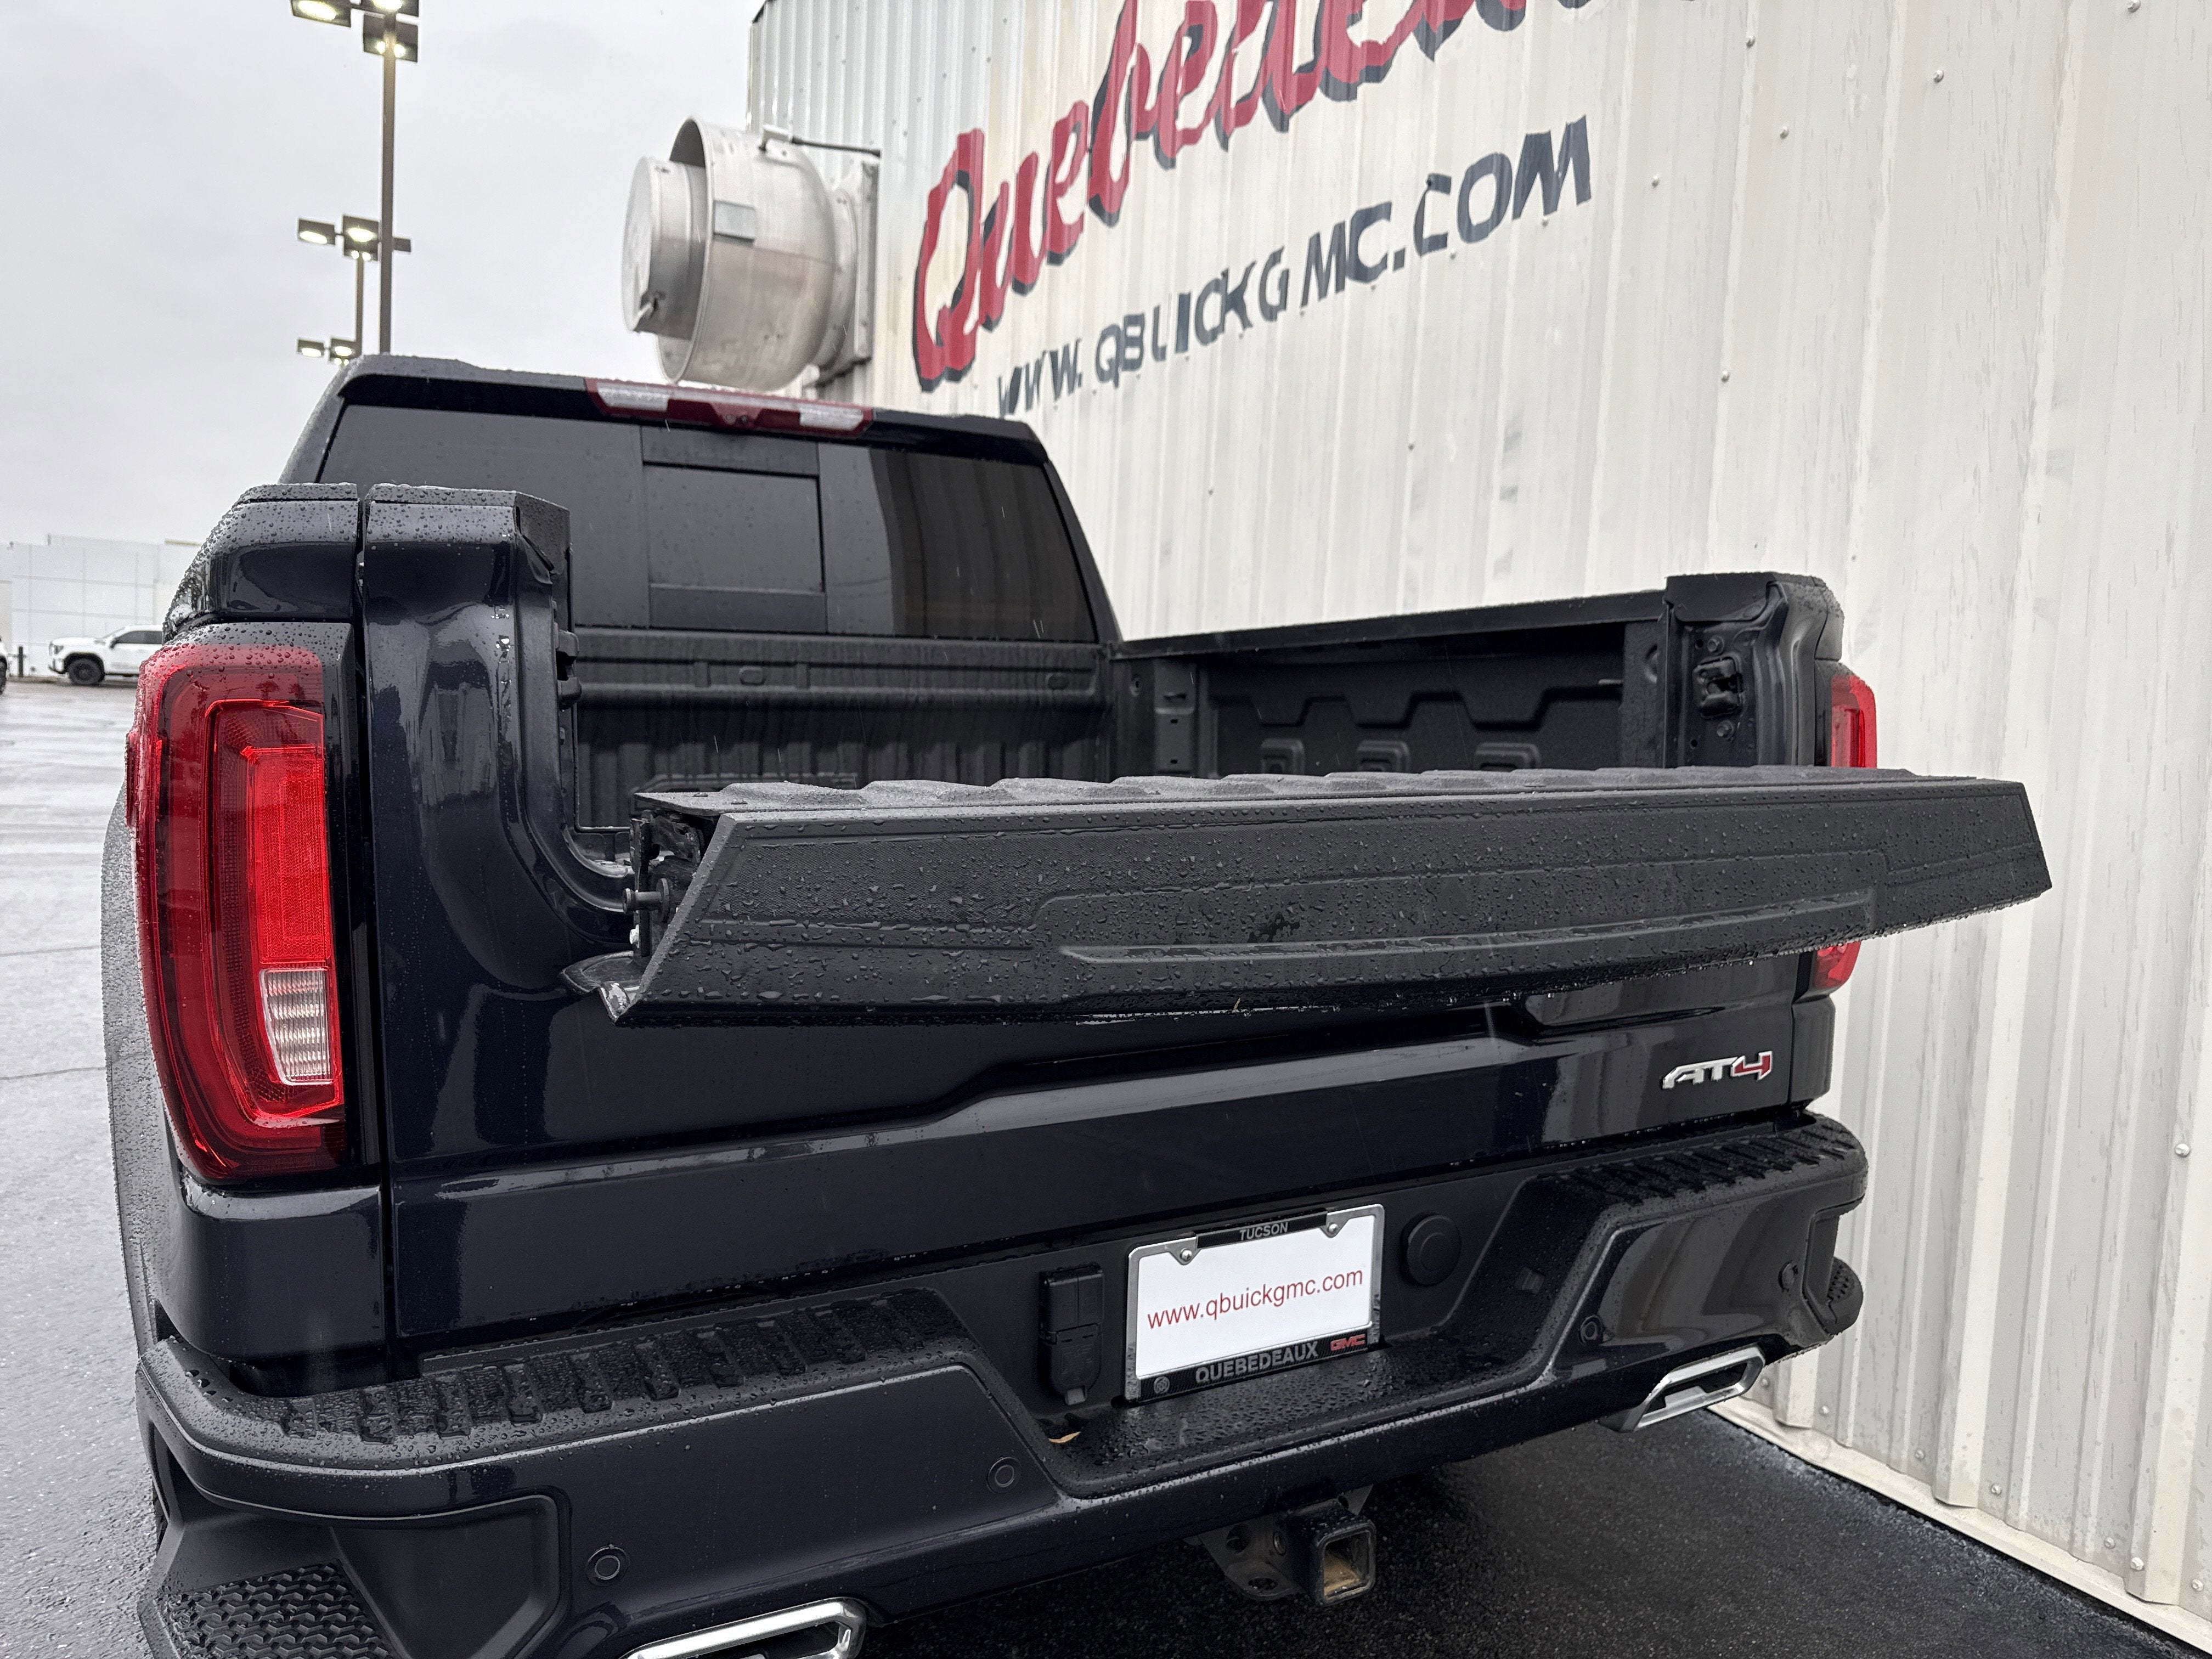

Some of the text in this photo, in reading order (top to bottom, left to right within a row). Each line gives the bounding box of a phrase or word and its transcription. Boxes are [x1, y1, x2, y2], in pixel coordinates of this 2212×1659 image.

[1662, 1050, 1773, 1090] AT4
[1239, 1221, 1289, 1242] TUCSON
[1147, 1268, 1363, 1329] www.qbuickgmc.com
[1330, 1333, 1366, 1351] GMC
[1195, 1341, 1319, 1384] QUEBEDEAUX
